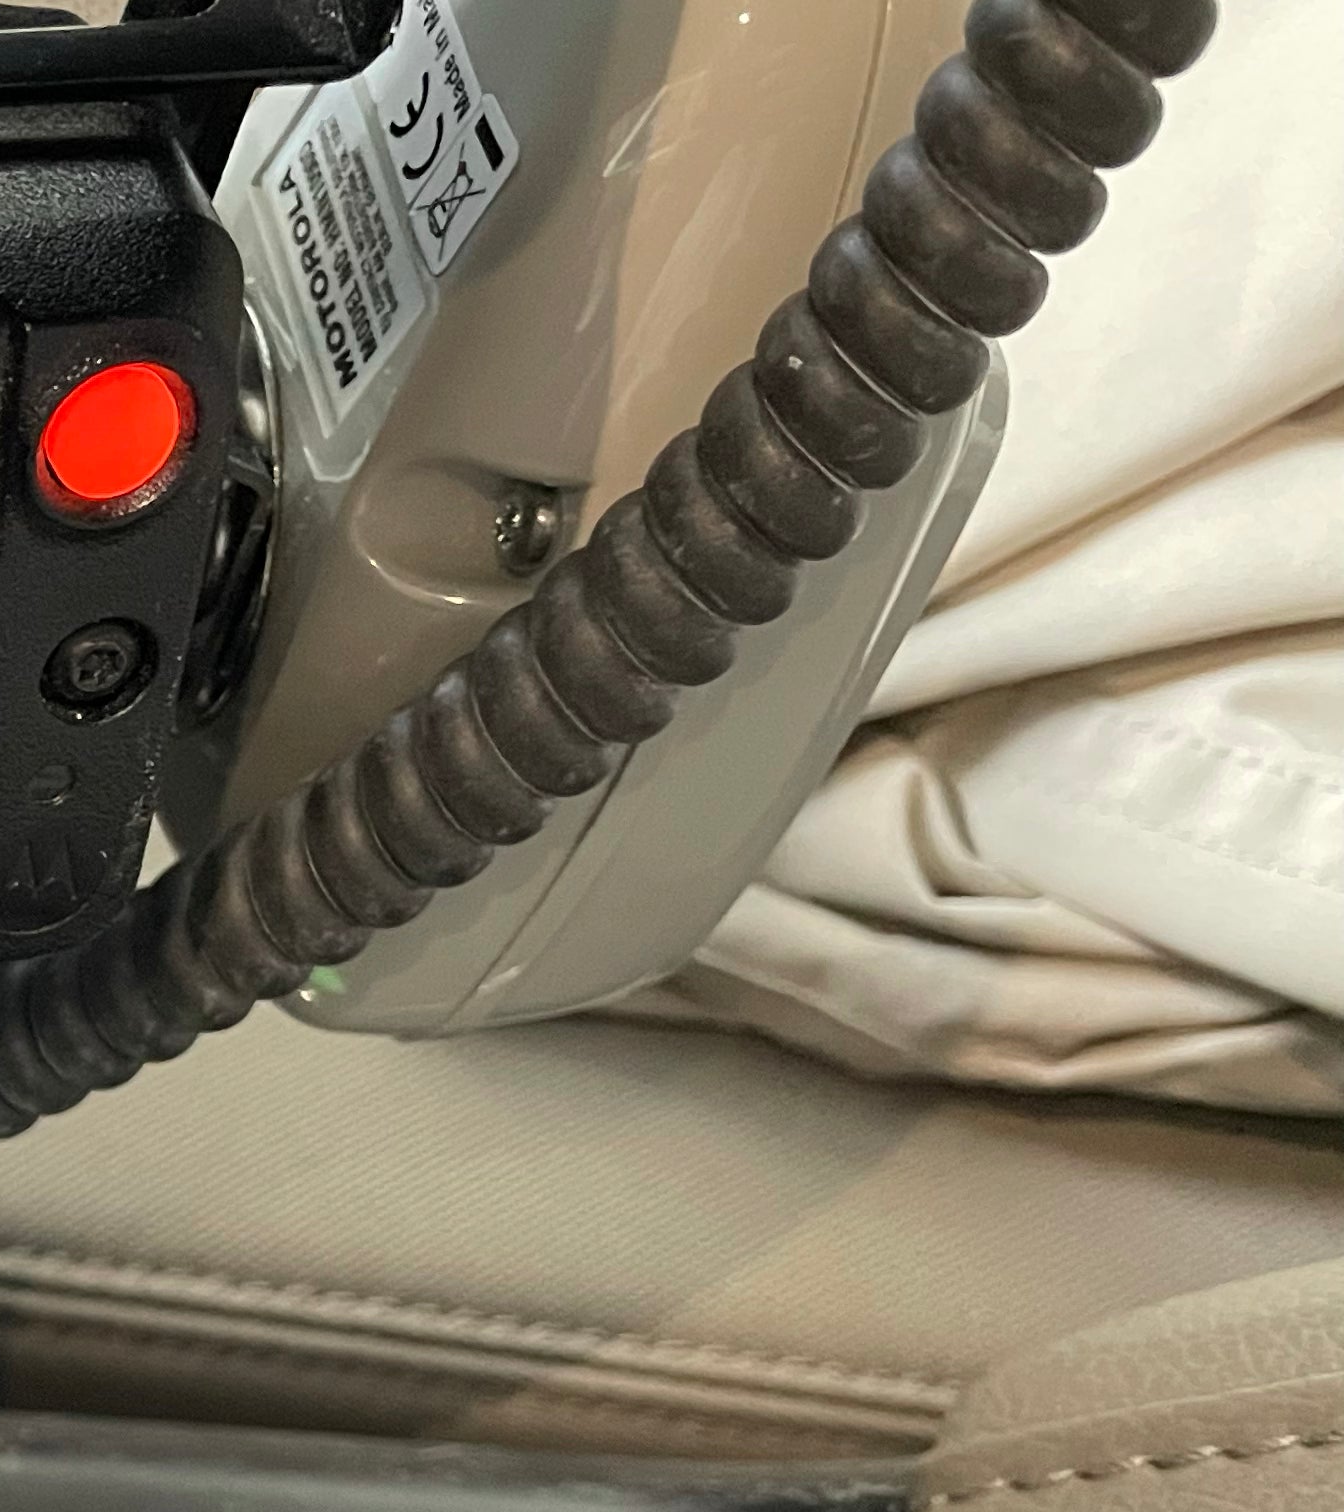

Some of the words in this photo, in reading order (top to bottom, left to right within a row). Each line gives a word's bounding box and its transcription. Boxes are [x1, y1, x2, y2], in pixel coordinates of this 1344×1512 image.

[435, 27, 450, 61] in
[444, 54, 472, 123] Made
[279, 165, 358, 389] MOTOROLA
[345, 279, 378, 363] MODEL
